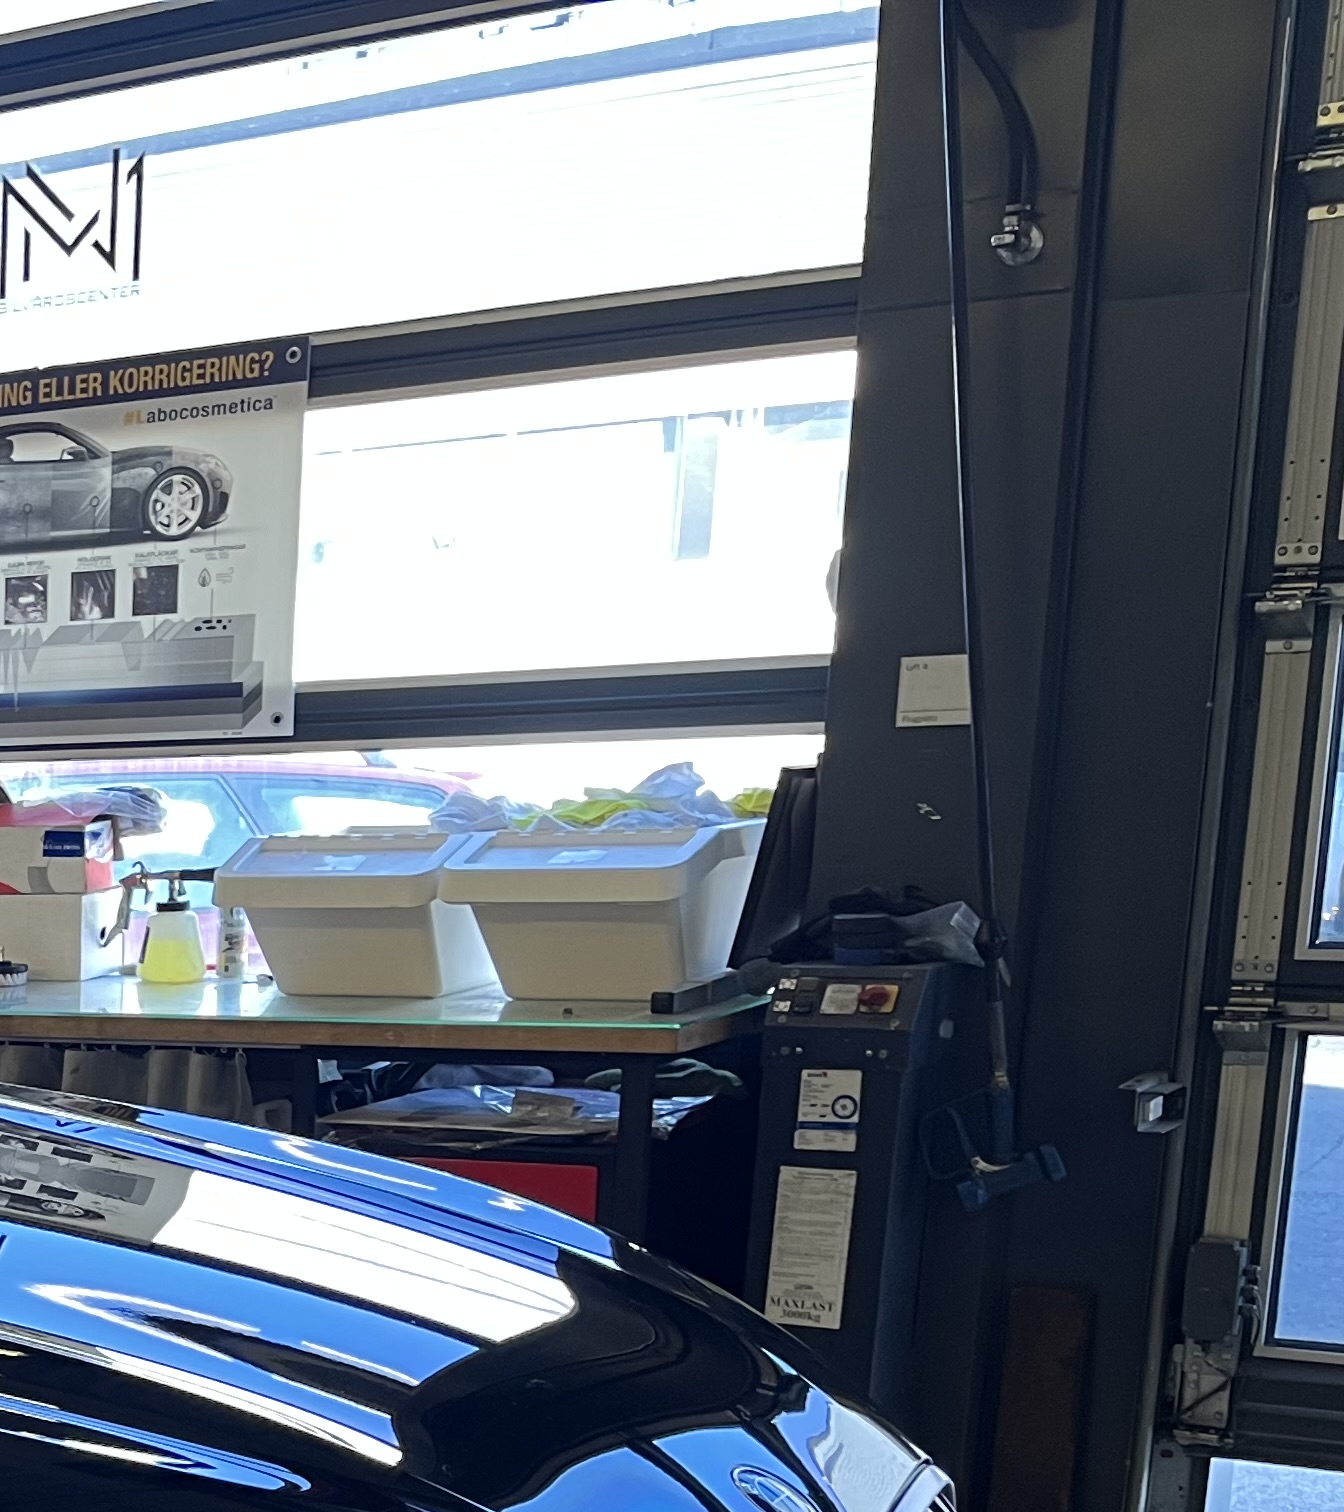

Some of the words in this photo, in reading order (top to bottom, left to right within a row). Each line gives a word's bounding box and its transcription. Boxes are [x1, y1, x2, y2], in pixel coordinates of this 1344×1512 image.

[38, 370, 103, 402] ELLER
[110, 351, 274, 394] KORRIGERING?
[769, 1295, 835, 1314] MAXLAST
